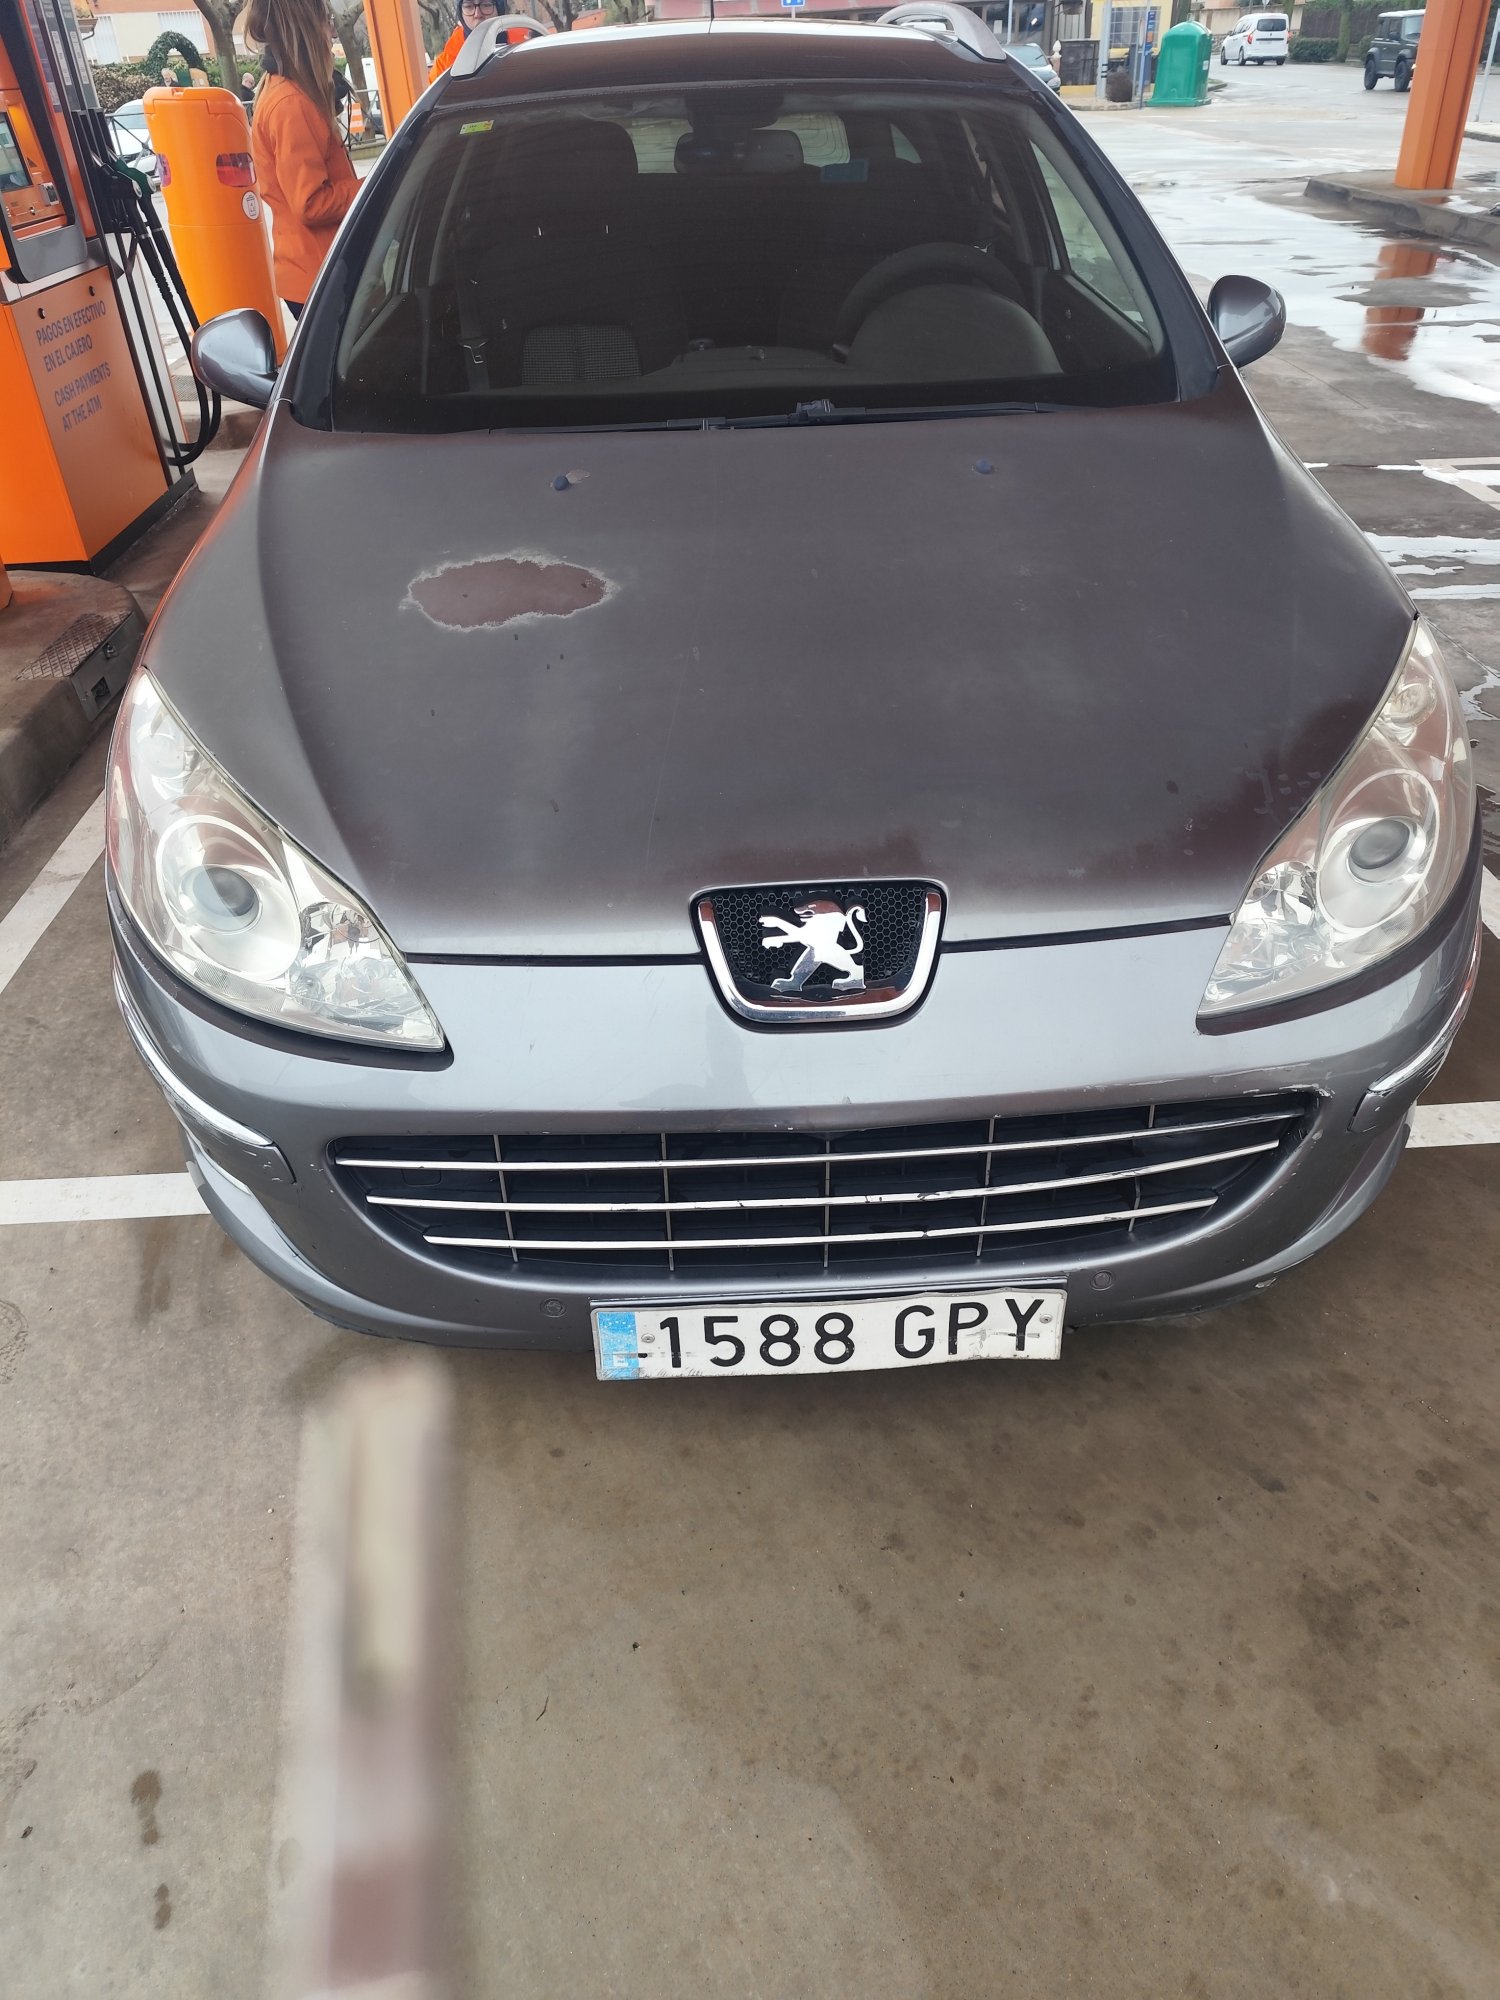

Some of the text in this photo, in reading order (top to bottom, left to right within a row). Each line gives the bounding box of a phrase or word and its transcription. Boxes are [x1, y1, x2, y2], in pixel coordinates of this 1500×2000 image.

[36, 300, 106, 346] PAGOS EN EFECTIVO
[43, 334, 93, 372] EN EL CAJERO
[54, 361, 111, 407] CASH PAYMENTS
[62, 395, 102, 432] AT THE ATM
[659, 1298, 1045, 1368] 1588 GPY
